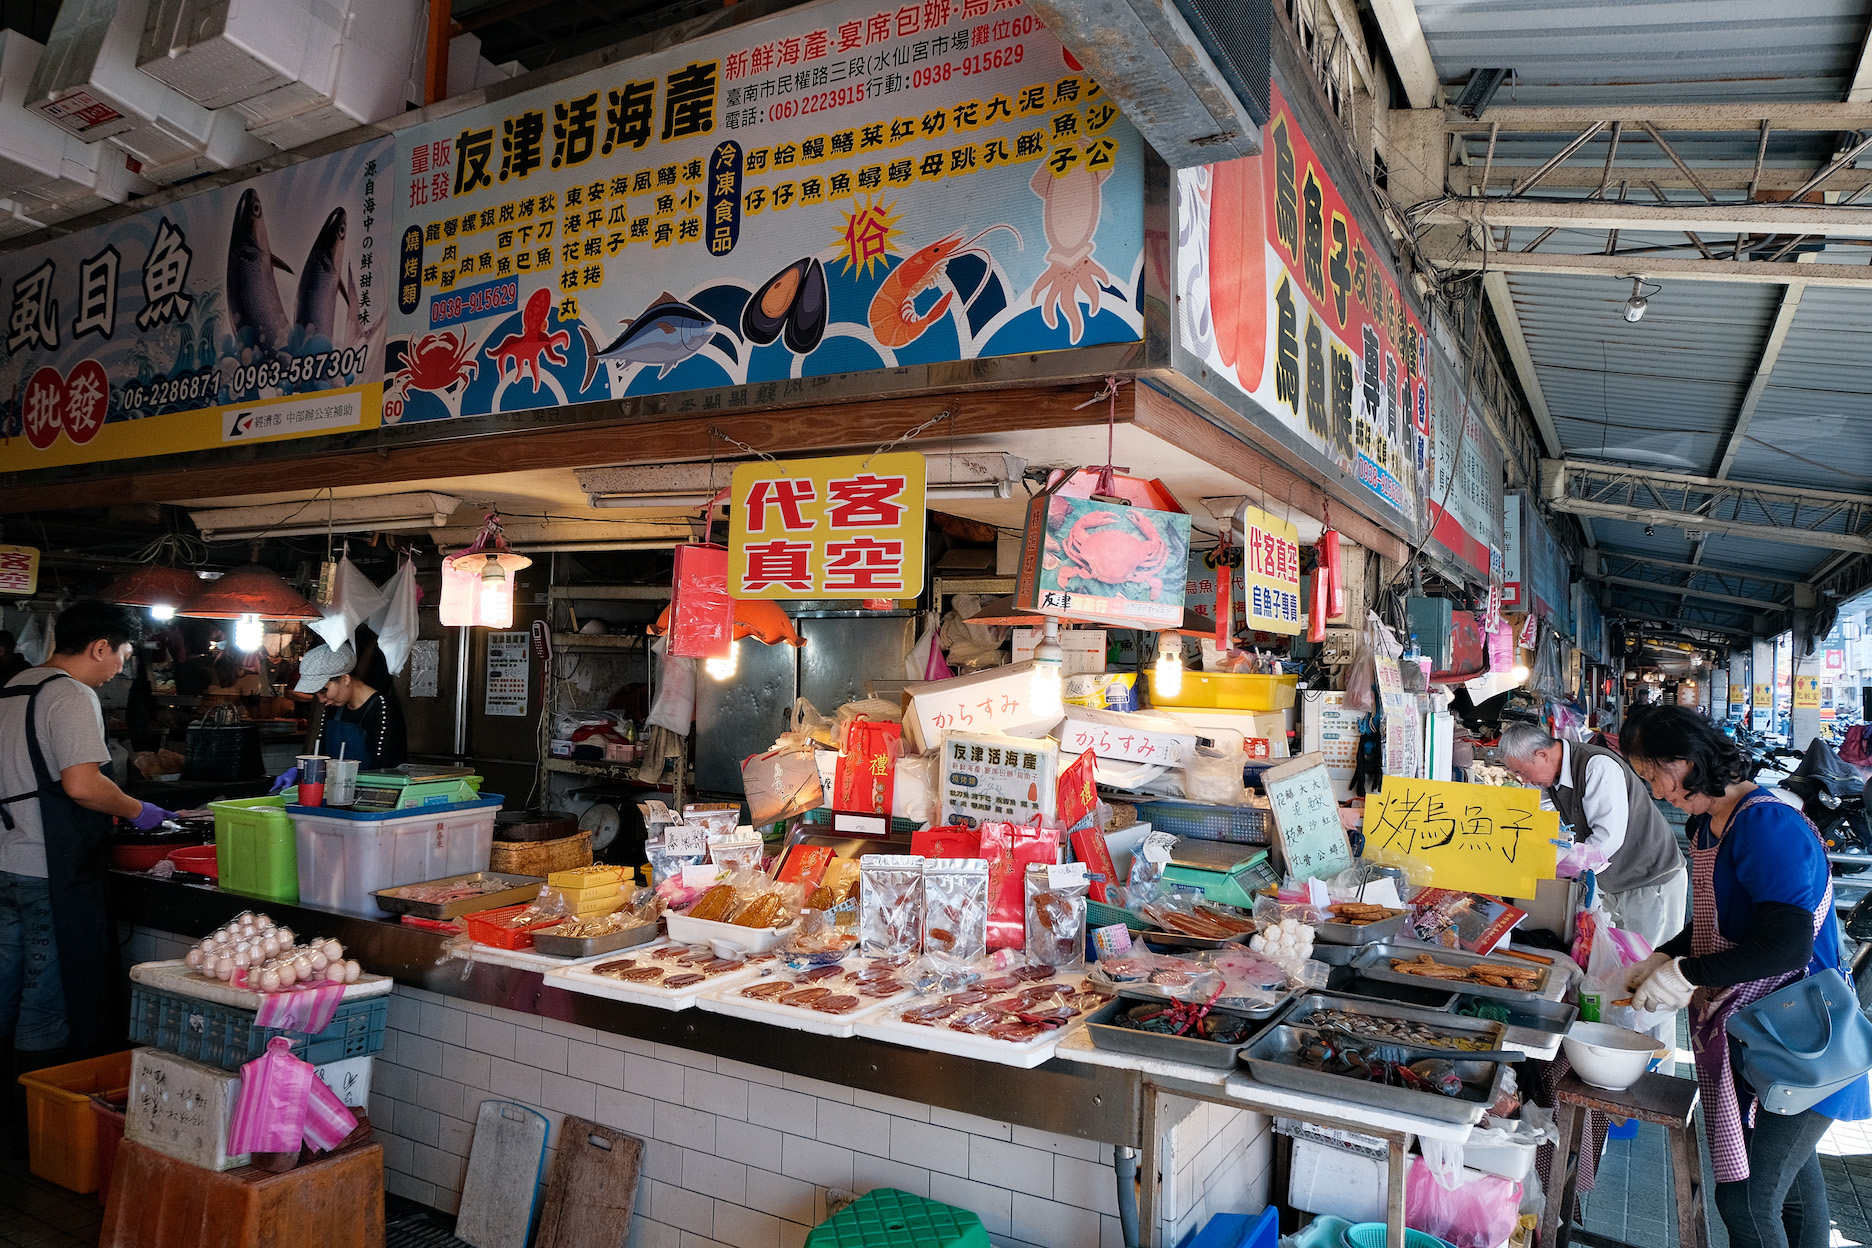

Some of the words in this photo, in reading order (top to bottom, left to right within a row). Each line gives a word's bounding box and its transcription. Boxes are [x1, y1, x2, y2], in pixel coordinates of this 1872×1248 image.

[454, 62, 718, 195] 友津活海產
[888, 119, 914, 182] 紅蟳
[919, 110, 945, 175] 幼母
[950, 103, 978, 169] 花跳
[983, 97, 1011, 162] 九孔
[1015, 90, 1044, 158] 泥鰍
[1050, 81, 1079, 173] 烏魚子
[410, 138, 451, 174] 量販
[745, 150, 768, 210] 蚵仔
[773, 145, 794, 205] 蛤仔
[800, 140, 824, 201] 鰻魚
[858, 126, 883, 188] 菜蟳
[409, 172, 450, 207] 批發
[606, 177, 628, 253] 海瓜子
[630, 172, 650, 238] 風螺
[679, 161, 701, 239] 凍小捲
[711, 145, 736, 252] 冷凍食品
[1272, 110, 1352, 329] 烏魚子
[356, 160, 377, 325] 源自海中の鮮甜美味
[424, 224, 441, 282] 龍珠
[460, 214, 476, 273] 螺肉
[478, 209, 495, 271] 銀魚
[516, 199, 534, 270] 烤下巴
[537, 194, 555, 266] 秋刀魚
[561, 187, 581, 318] 東港花枝丸
[583, 182, 606, 285] 安平蝦捲
[845, 205, 888, 264] 俗
[7, 217, 193, 355] 虱目魚
[403, 231, 420, 305] 燒烤類
[432, 284, 516, 322] 0938-915629
[28, 371, 104, 437] 批發
[124, 370, 221, 410] 06-2286871
[232, 347, 368, 392] 0963-587301
[384, 399, 402, 417] 60
[745, 474, 908, 533] 代客
[741, 536, 904, 592] 真空
[1250, 526, 1298, 584] 代客真空
[1253, 585, 1297, 622] 烏魚子專賣
[932, 694, 1020, 729] からすみ
[868, 753, 889, 776] 禮
[954, 743, 1037, 770] 友津活海產
[1075, 730, 1156, 758] からすみ
[842, 751, 857, 803] からすみ
[1371, 788, 1533, 864] 烤烏魚子
